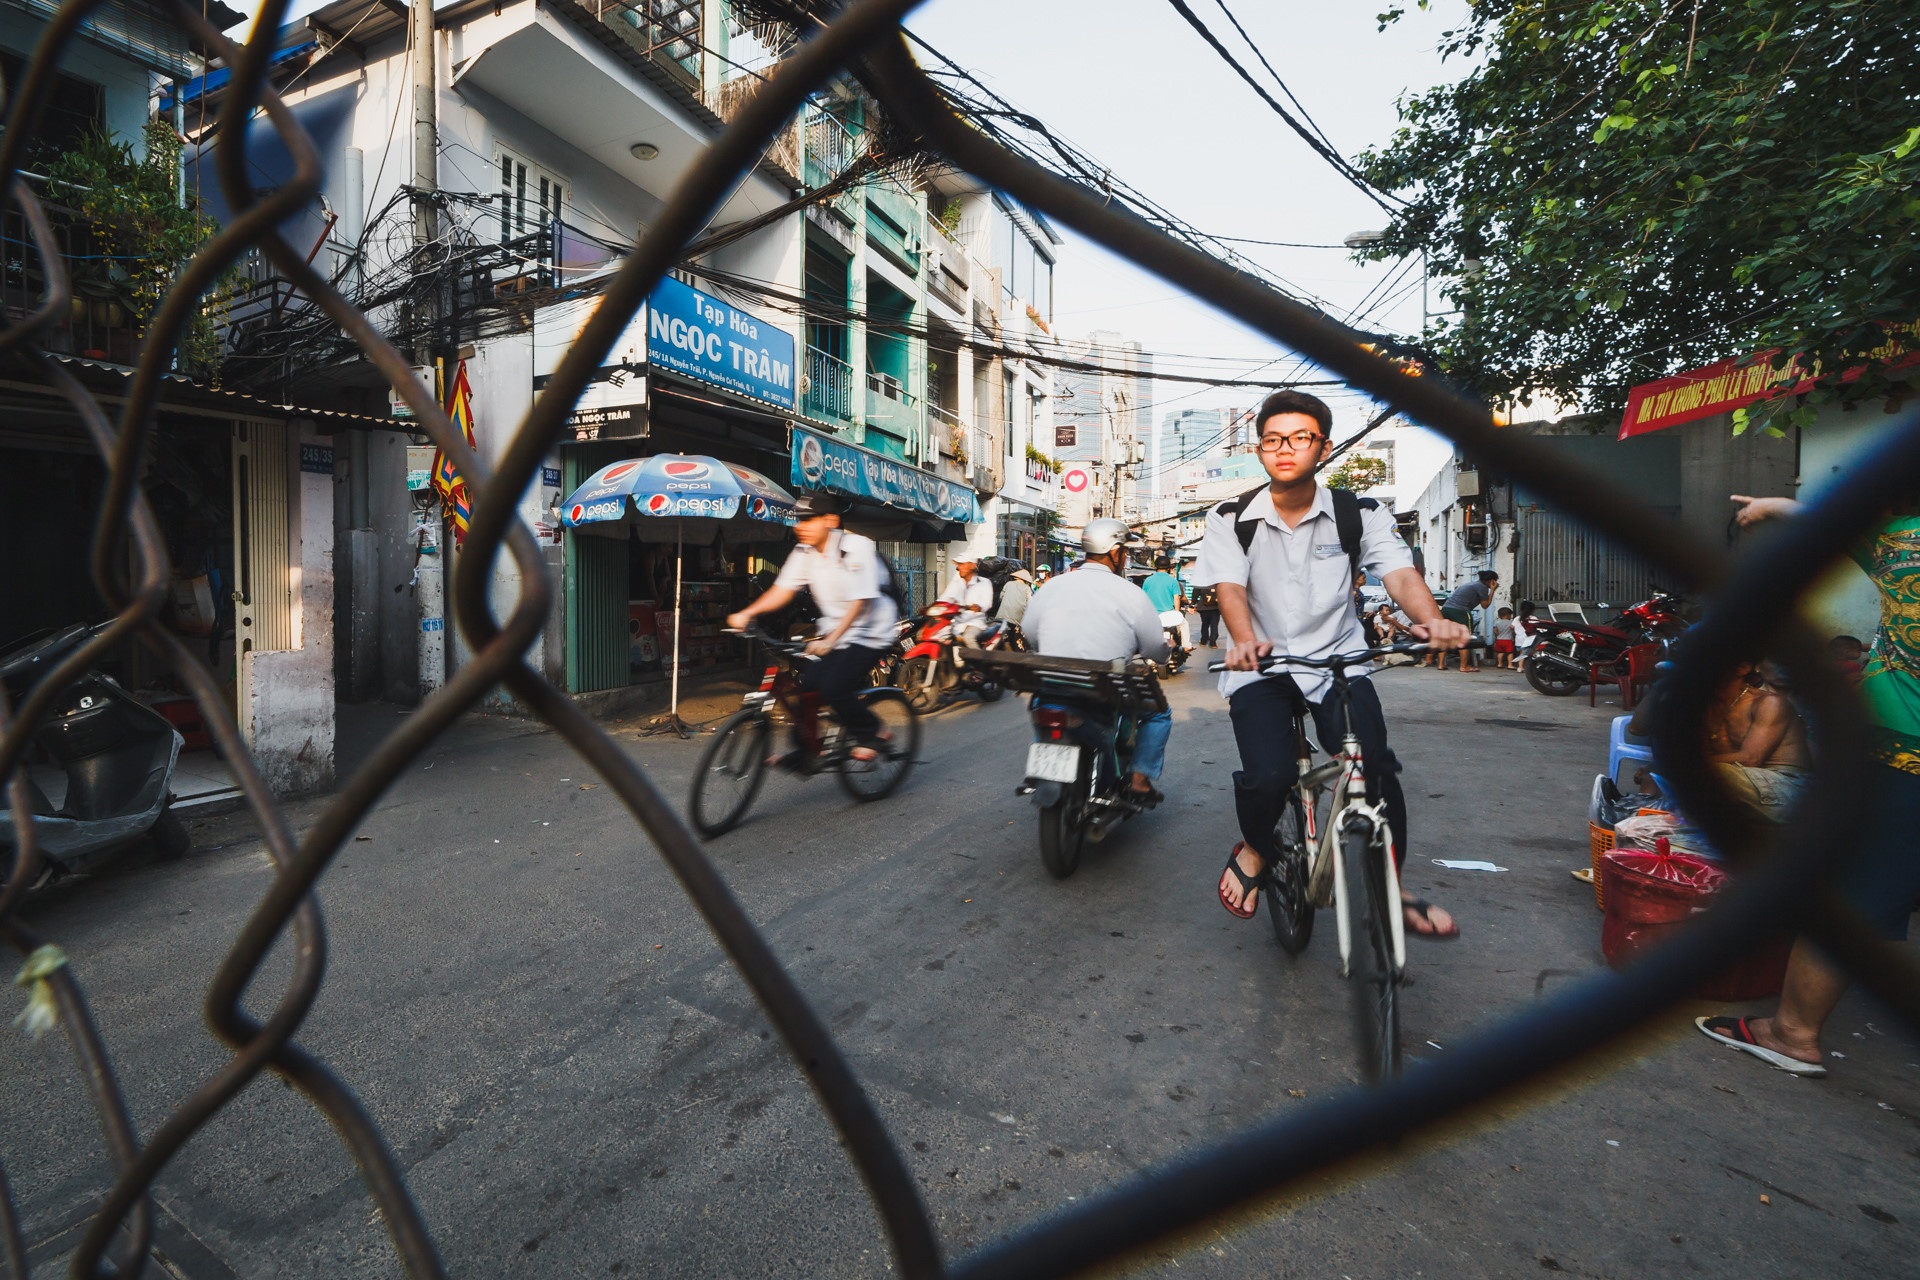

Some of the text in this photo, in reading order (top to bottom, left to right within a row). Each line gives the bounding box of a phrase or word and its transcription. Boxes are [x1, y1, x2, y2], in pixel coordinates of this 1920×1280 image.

[693, 293, 758, 340] Tạp Hóa
[650, 307, 790, 389] NGỌC TRÂM
[1669, 379, 1704, 415] KHÔNG
[582, 413, 606, 424] NGỌC
[607, 409, 631, 420] TRÂM
[824, 453, 857, 479] pepsi
[863, 454, 879, 482] Tạp
[898, 467, 918, 493] Ngọc
[666, 482, 711, 490] pepsi
[586, 499, 619, 518] pepsi
[676, 498, 723, 512] pepsi
